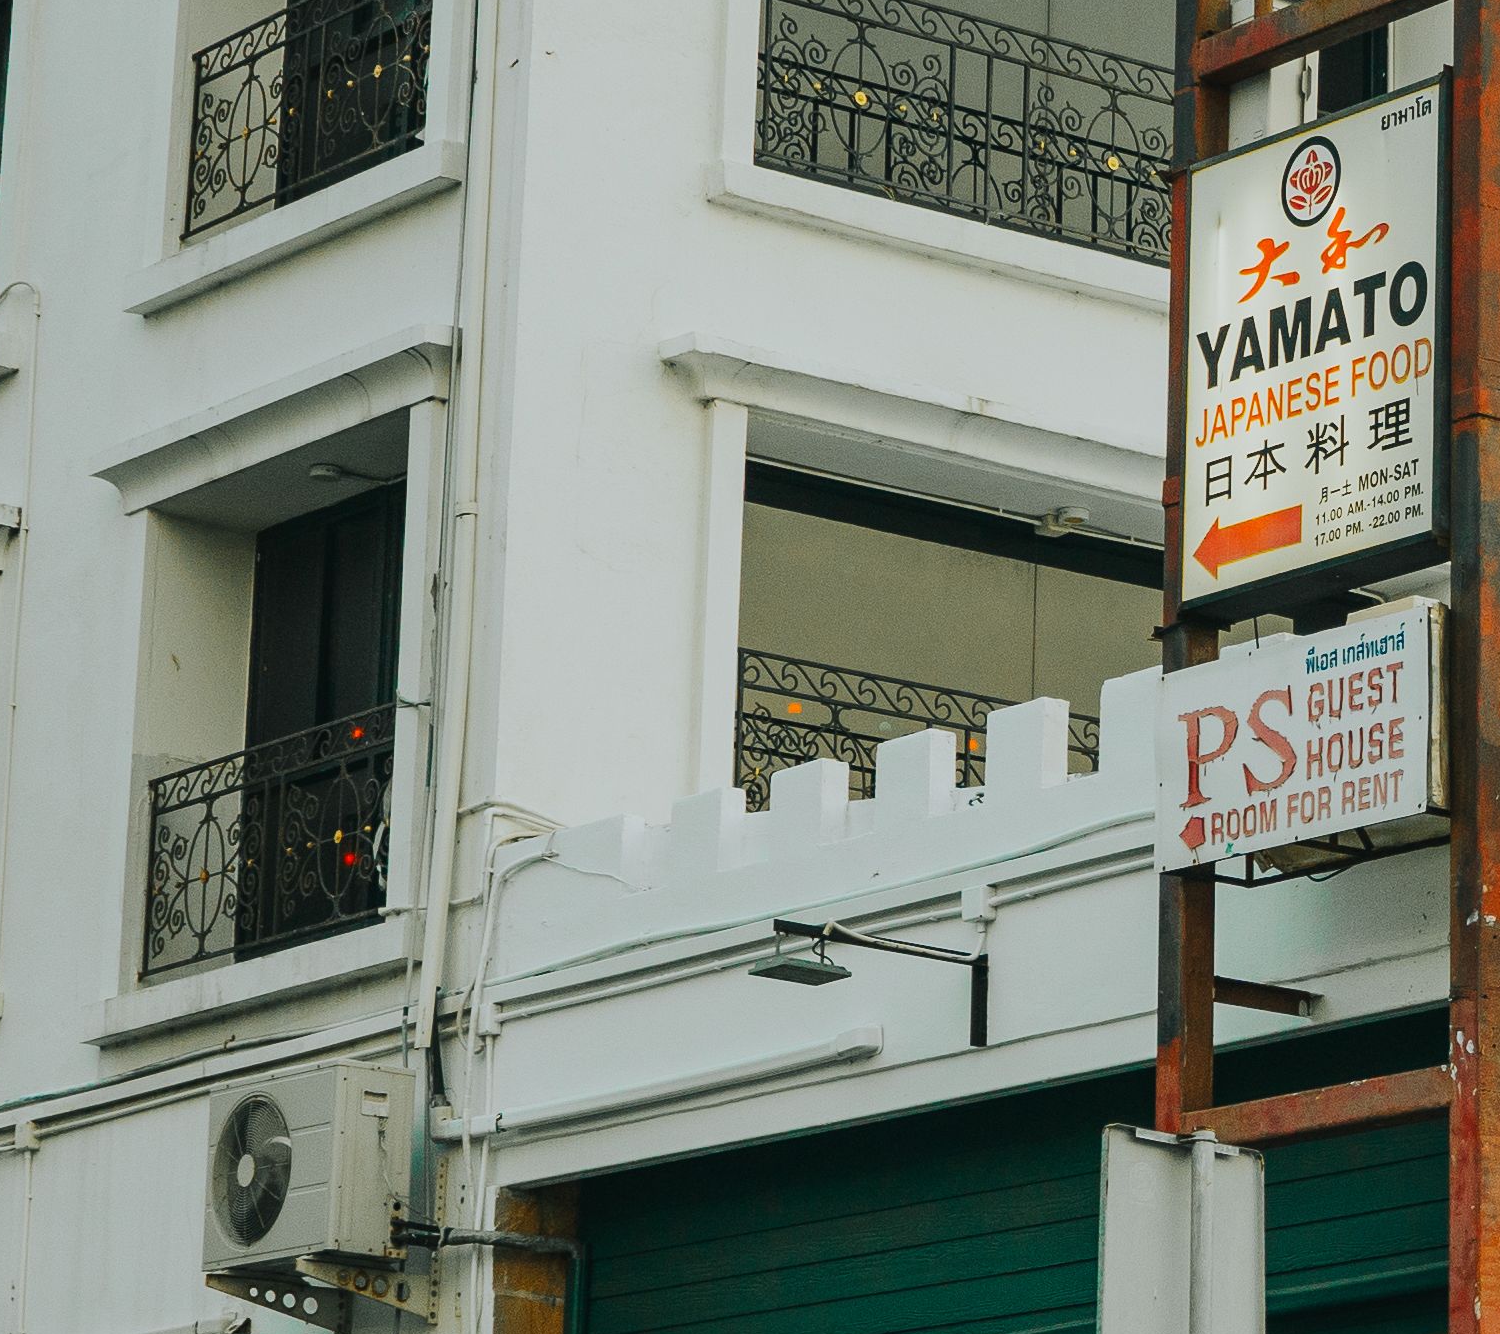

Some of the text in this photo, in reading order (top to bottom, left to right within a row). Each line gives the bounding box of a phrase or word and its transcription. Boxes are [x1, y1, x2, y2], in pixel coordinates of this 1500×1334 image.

[1195, 260, 1429, 390] YAMATO
[1194, 336, 1433, 449] JAPANESE FOOD
[1314, 506, 1344, 527] 11.00
[1403, 483, 1425, 500] PM.
[1357, 458, 1421, 494] MON-SAT
[1313, 526, 1342, 547] 17.00
[1344, 518, 1365, 535] PM.
[1404, 503, 1425, 521] PM.
[1306, 661, 1405, 724] GUEST
[1177, 684, 1299, 811] PS
[1305, 716, 1406, 782] HOUSE
[1211, 768, 1405, 846] ROOM FOR RENT
